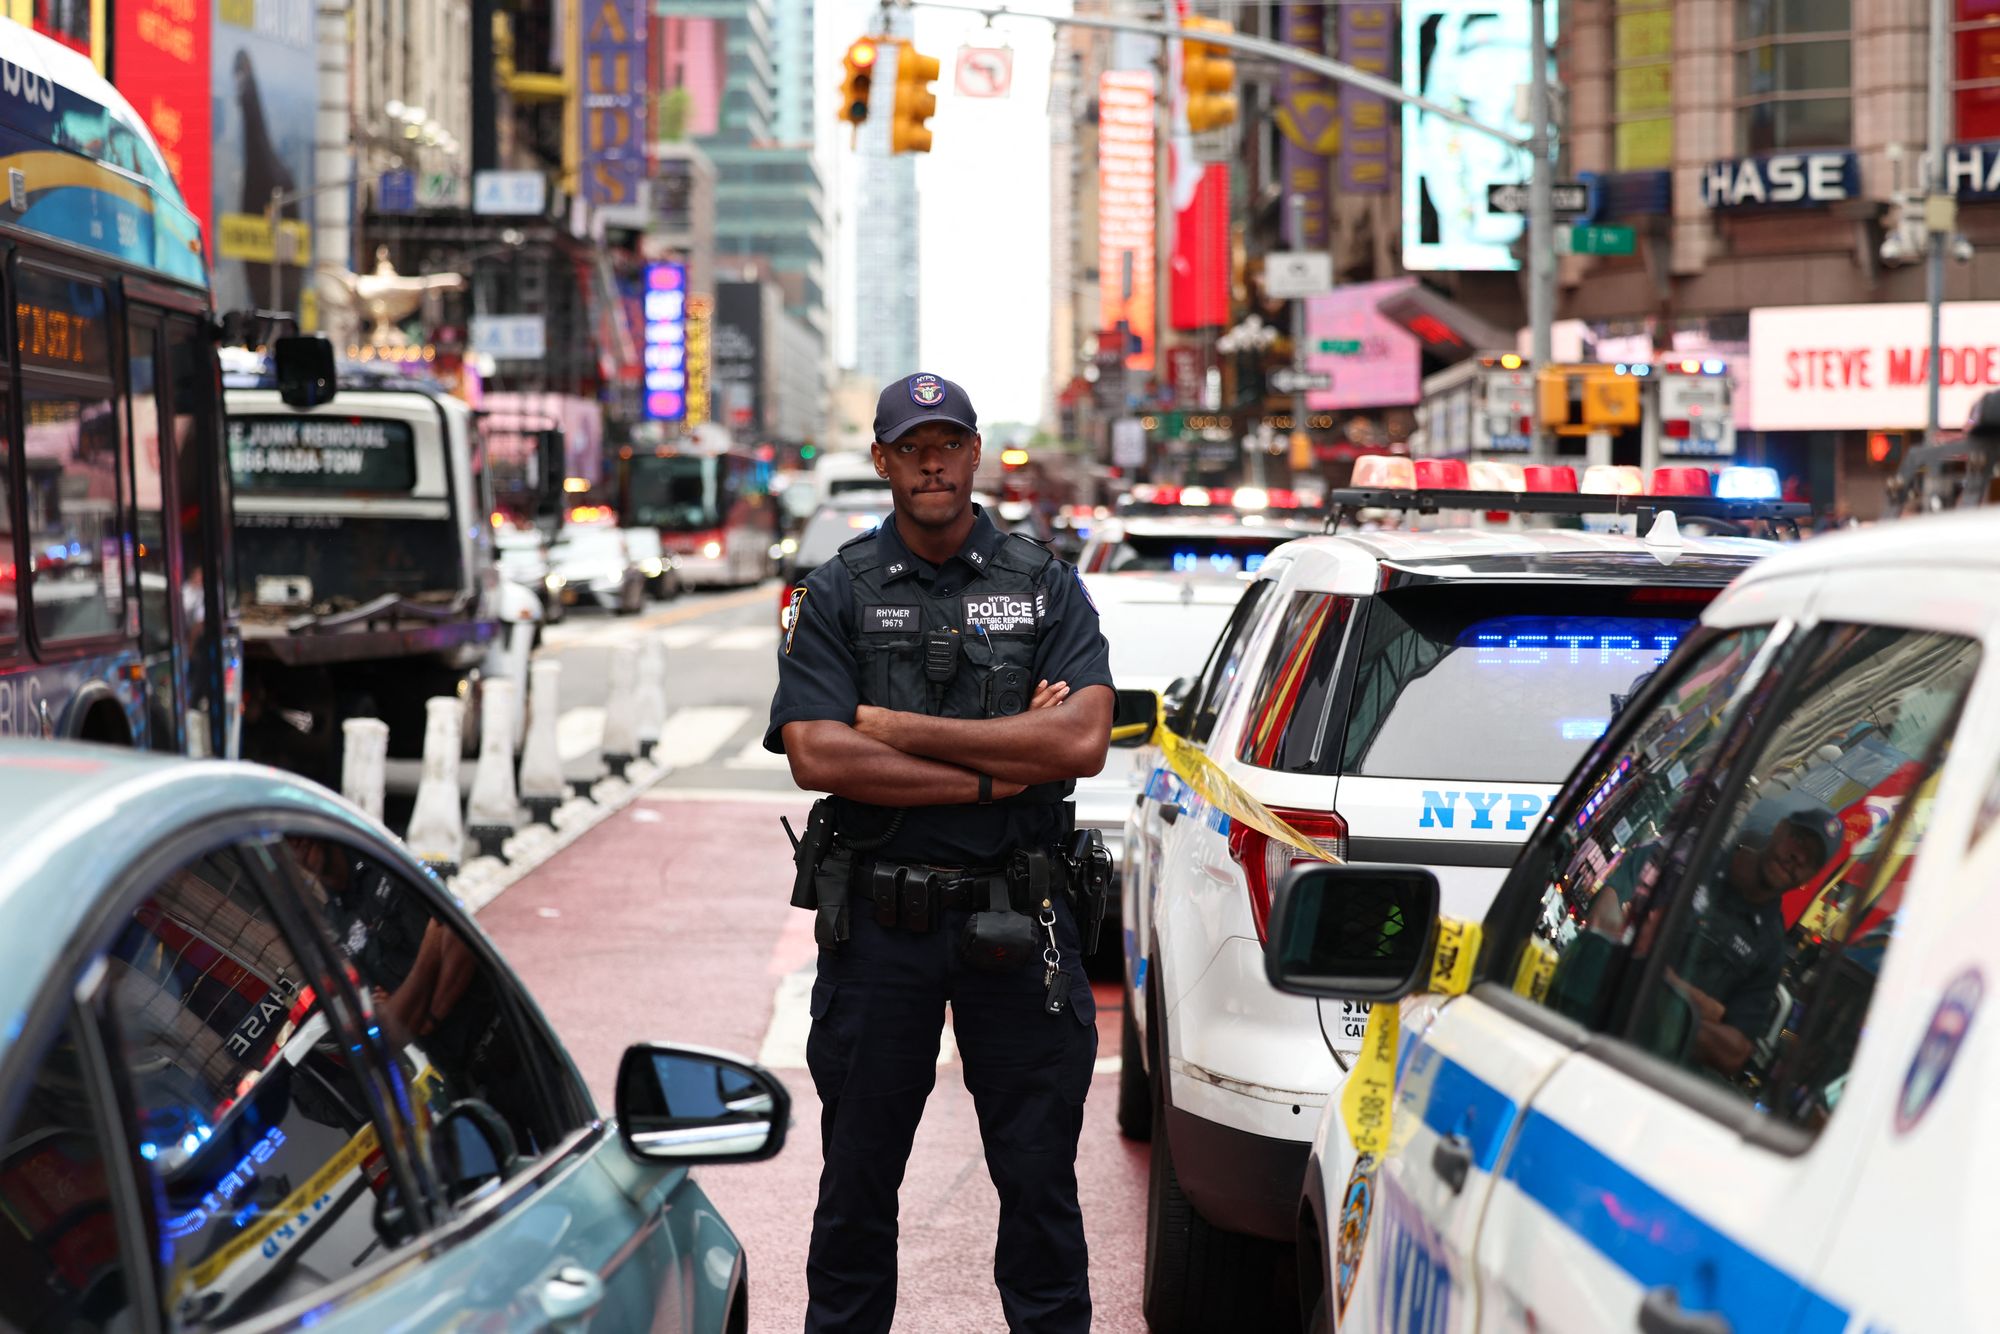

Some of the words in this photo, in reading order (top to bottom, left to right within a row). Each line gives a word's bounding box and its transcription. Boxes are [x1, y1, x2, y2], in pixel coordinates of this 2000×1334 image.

[1706, 155, 1846, 205] HASE
[1787, 349, 1871, 388] STEVE
[917, 375, 936, 383] NYPD
[302, 424, 388, 449] REMOVAL
[971, 552, 983, 564] S3
[890, 564, 903, 574] S3
[876, 609, 910, 618] RHYMER
[967, 602, 1033, 618] POLICE
[881, 619, 904, 628] 19679
[967, 617, 1002, 625] STRATEGIC
[1003, 616, 1035, 625] RESPONSE
[1419, 790, 1556, 831] NYP
